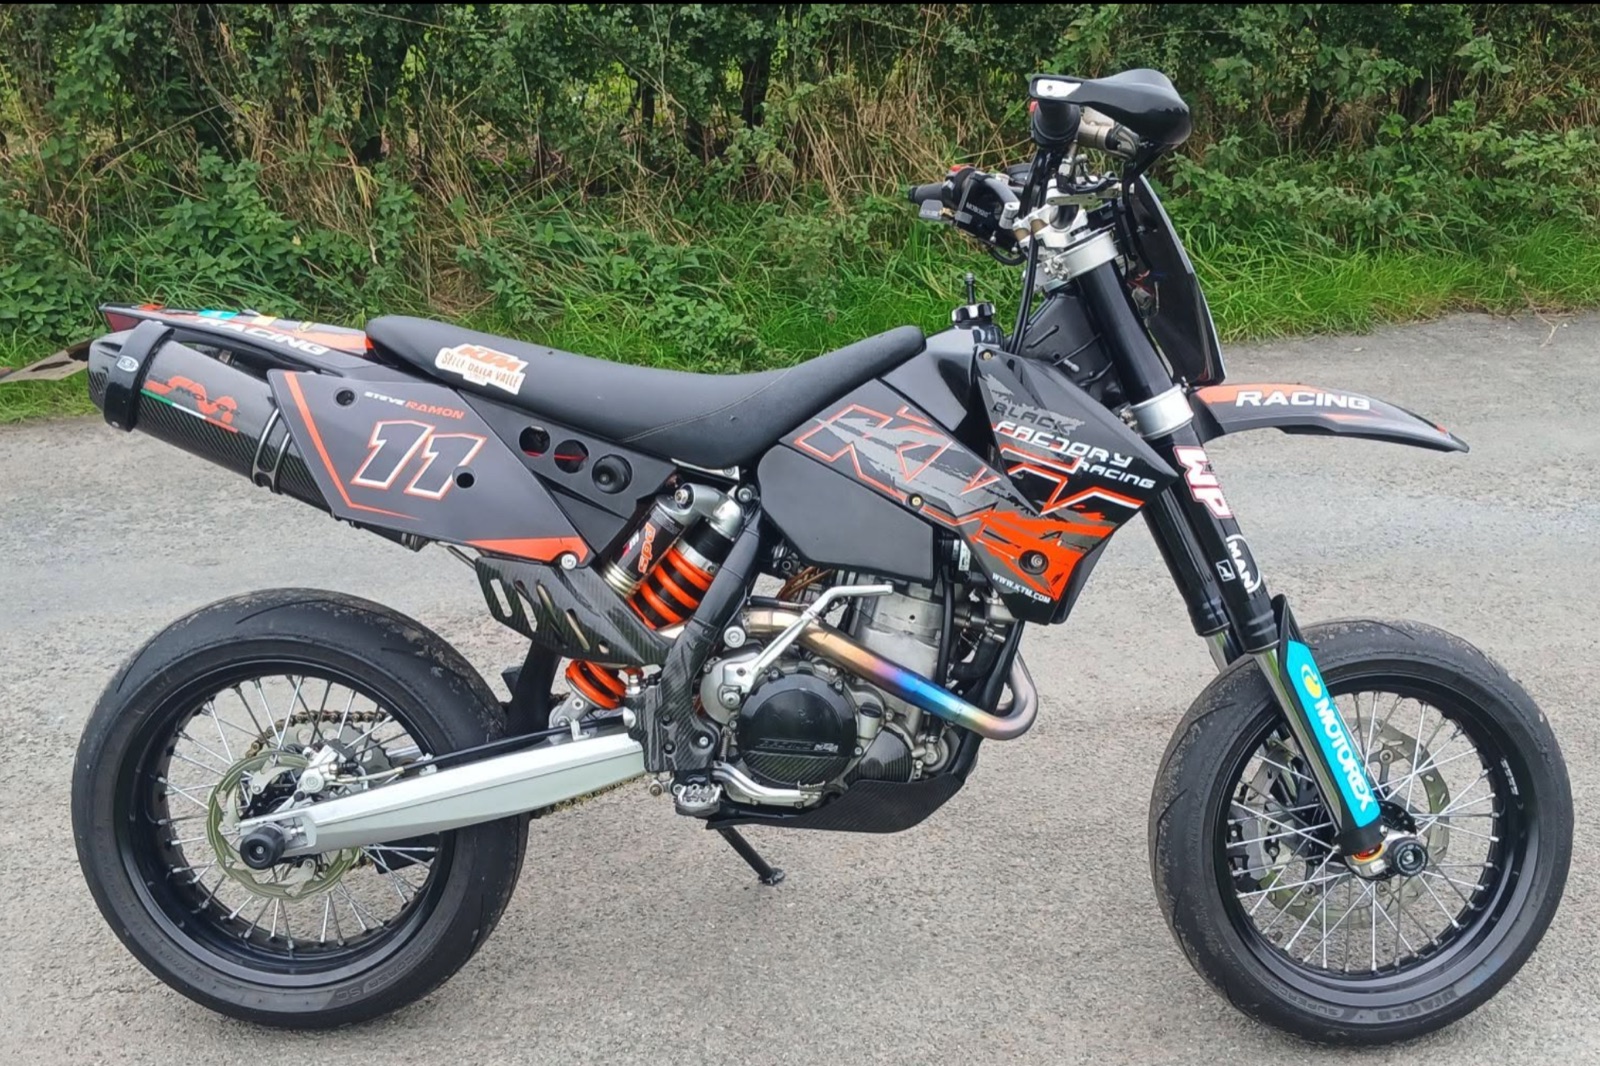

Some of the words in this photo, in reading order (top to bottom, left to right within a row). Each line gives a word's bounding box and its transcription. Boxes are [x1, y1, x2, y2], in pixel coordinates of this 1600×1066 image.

[992, 401, 1073, 434] BLACK
[1235, 391, 1370, 410] RACING
[350, 419, 487, 500] 11
[993, 420, 1133, 468] FACTORY
[1077, 457, 1157, 489] RACING
[1173, 446, 1234, 519] WP
[991, 571, 1052, 604] WWW.KTM.COM
[1226, 539, 1257, 593] MAN
[1314, 697, 1374, 812] MOTOREX
